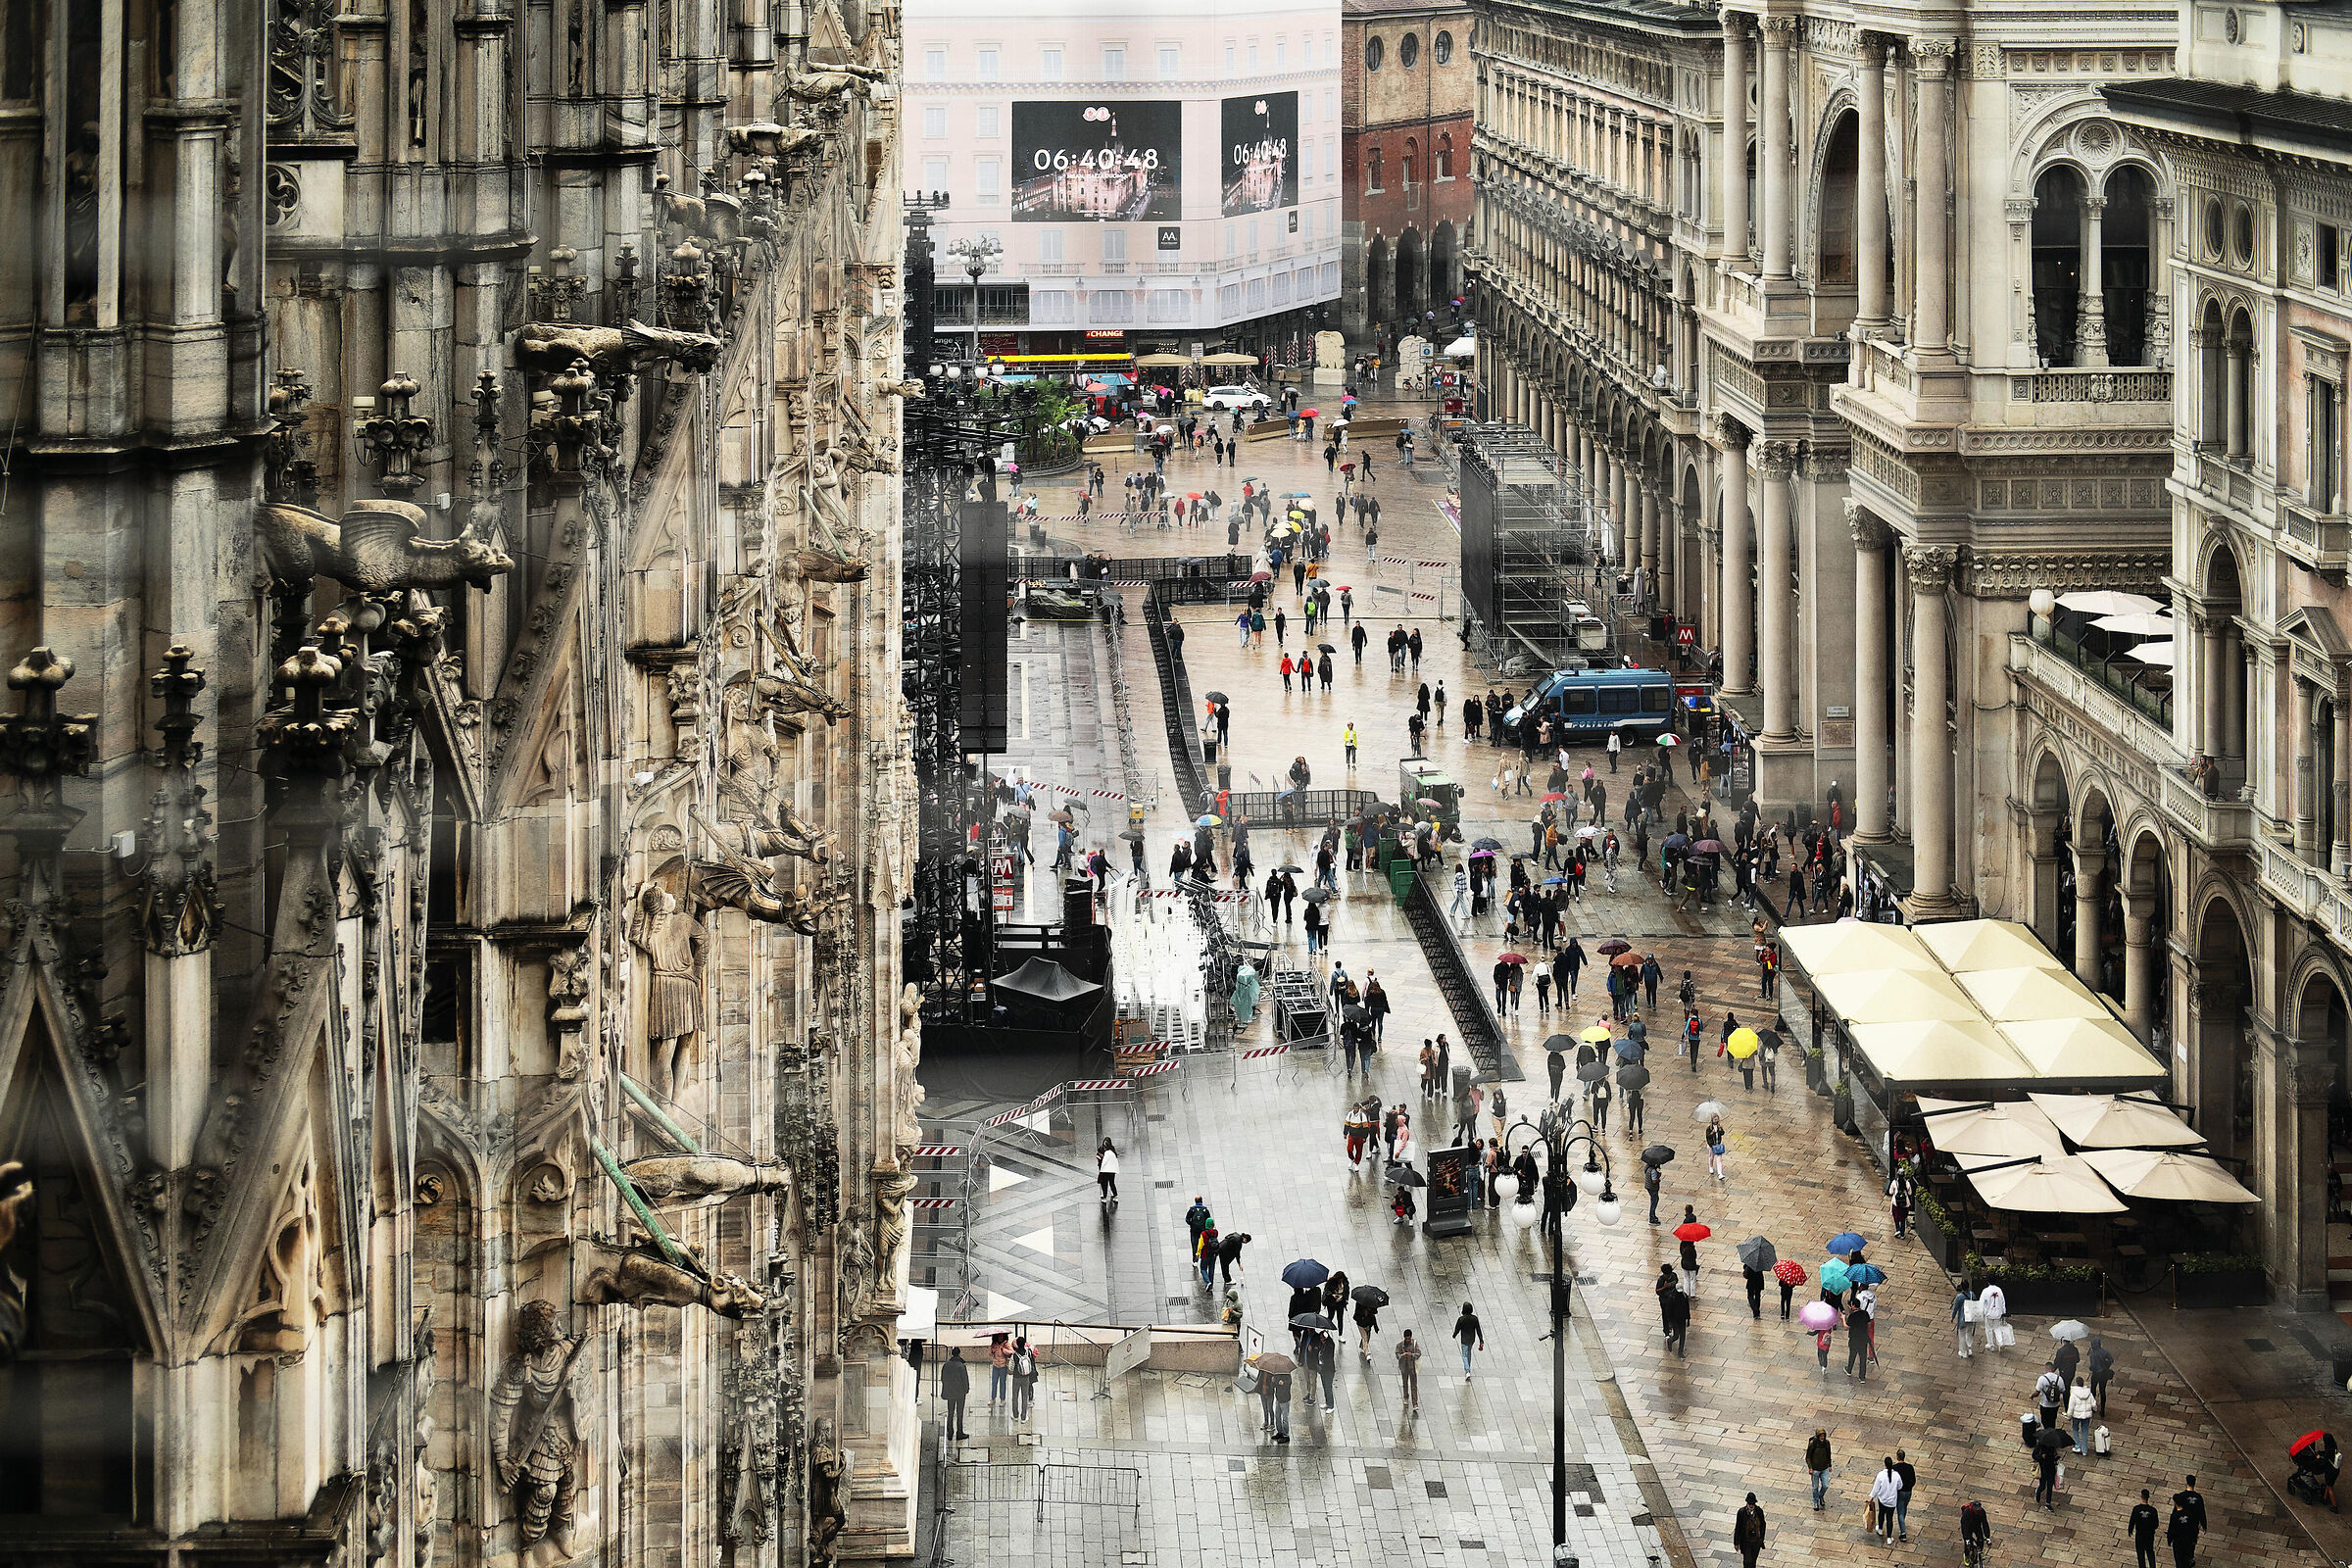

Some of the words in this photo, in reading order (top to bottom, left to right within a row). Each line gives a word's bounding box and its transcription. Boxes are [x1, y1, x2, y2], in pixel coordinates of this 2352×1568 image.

[1034, 148, 1159, 171] 06:40:48
[1234, 137, 1287, 166] 06:40:48
[1443, 375, 1453, 384] M
[1679, 628, 1693, 640] M
[994, 858, 1012, 874] M
